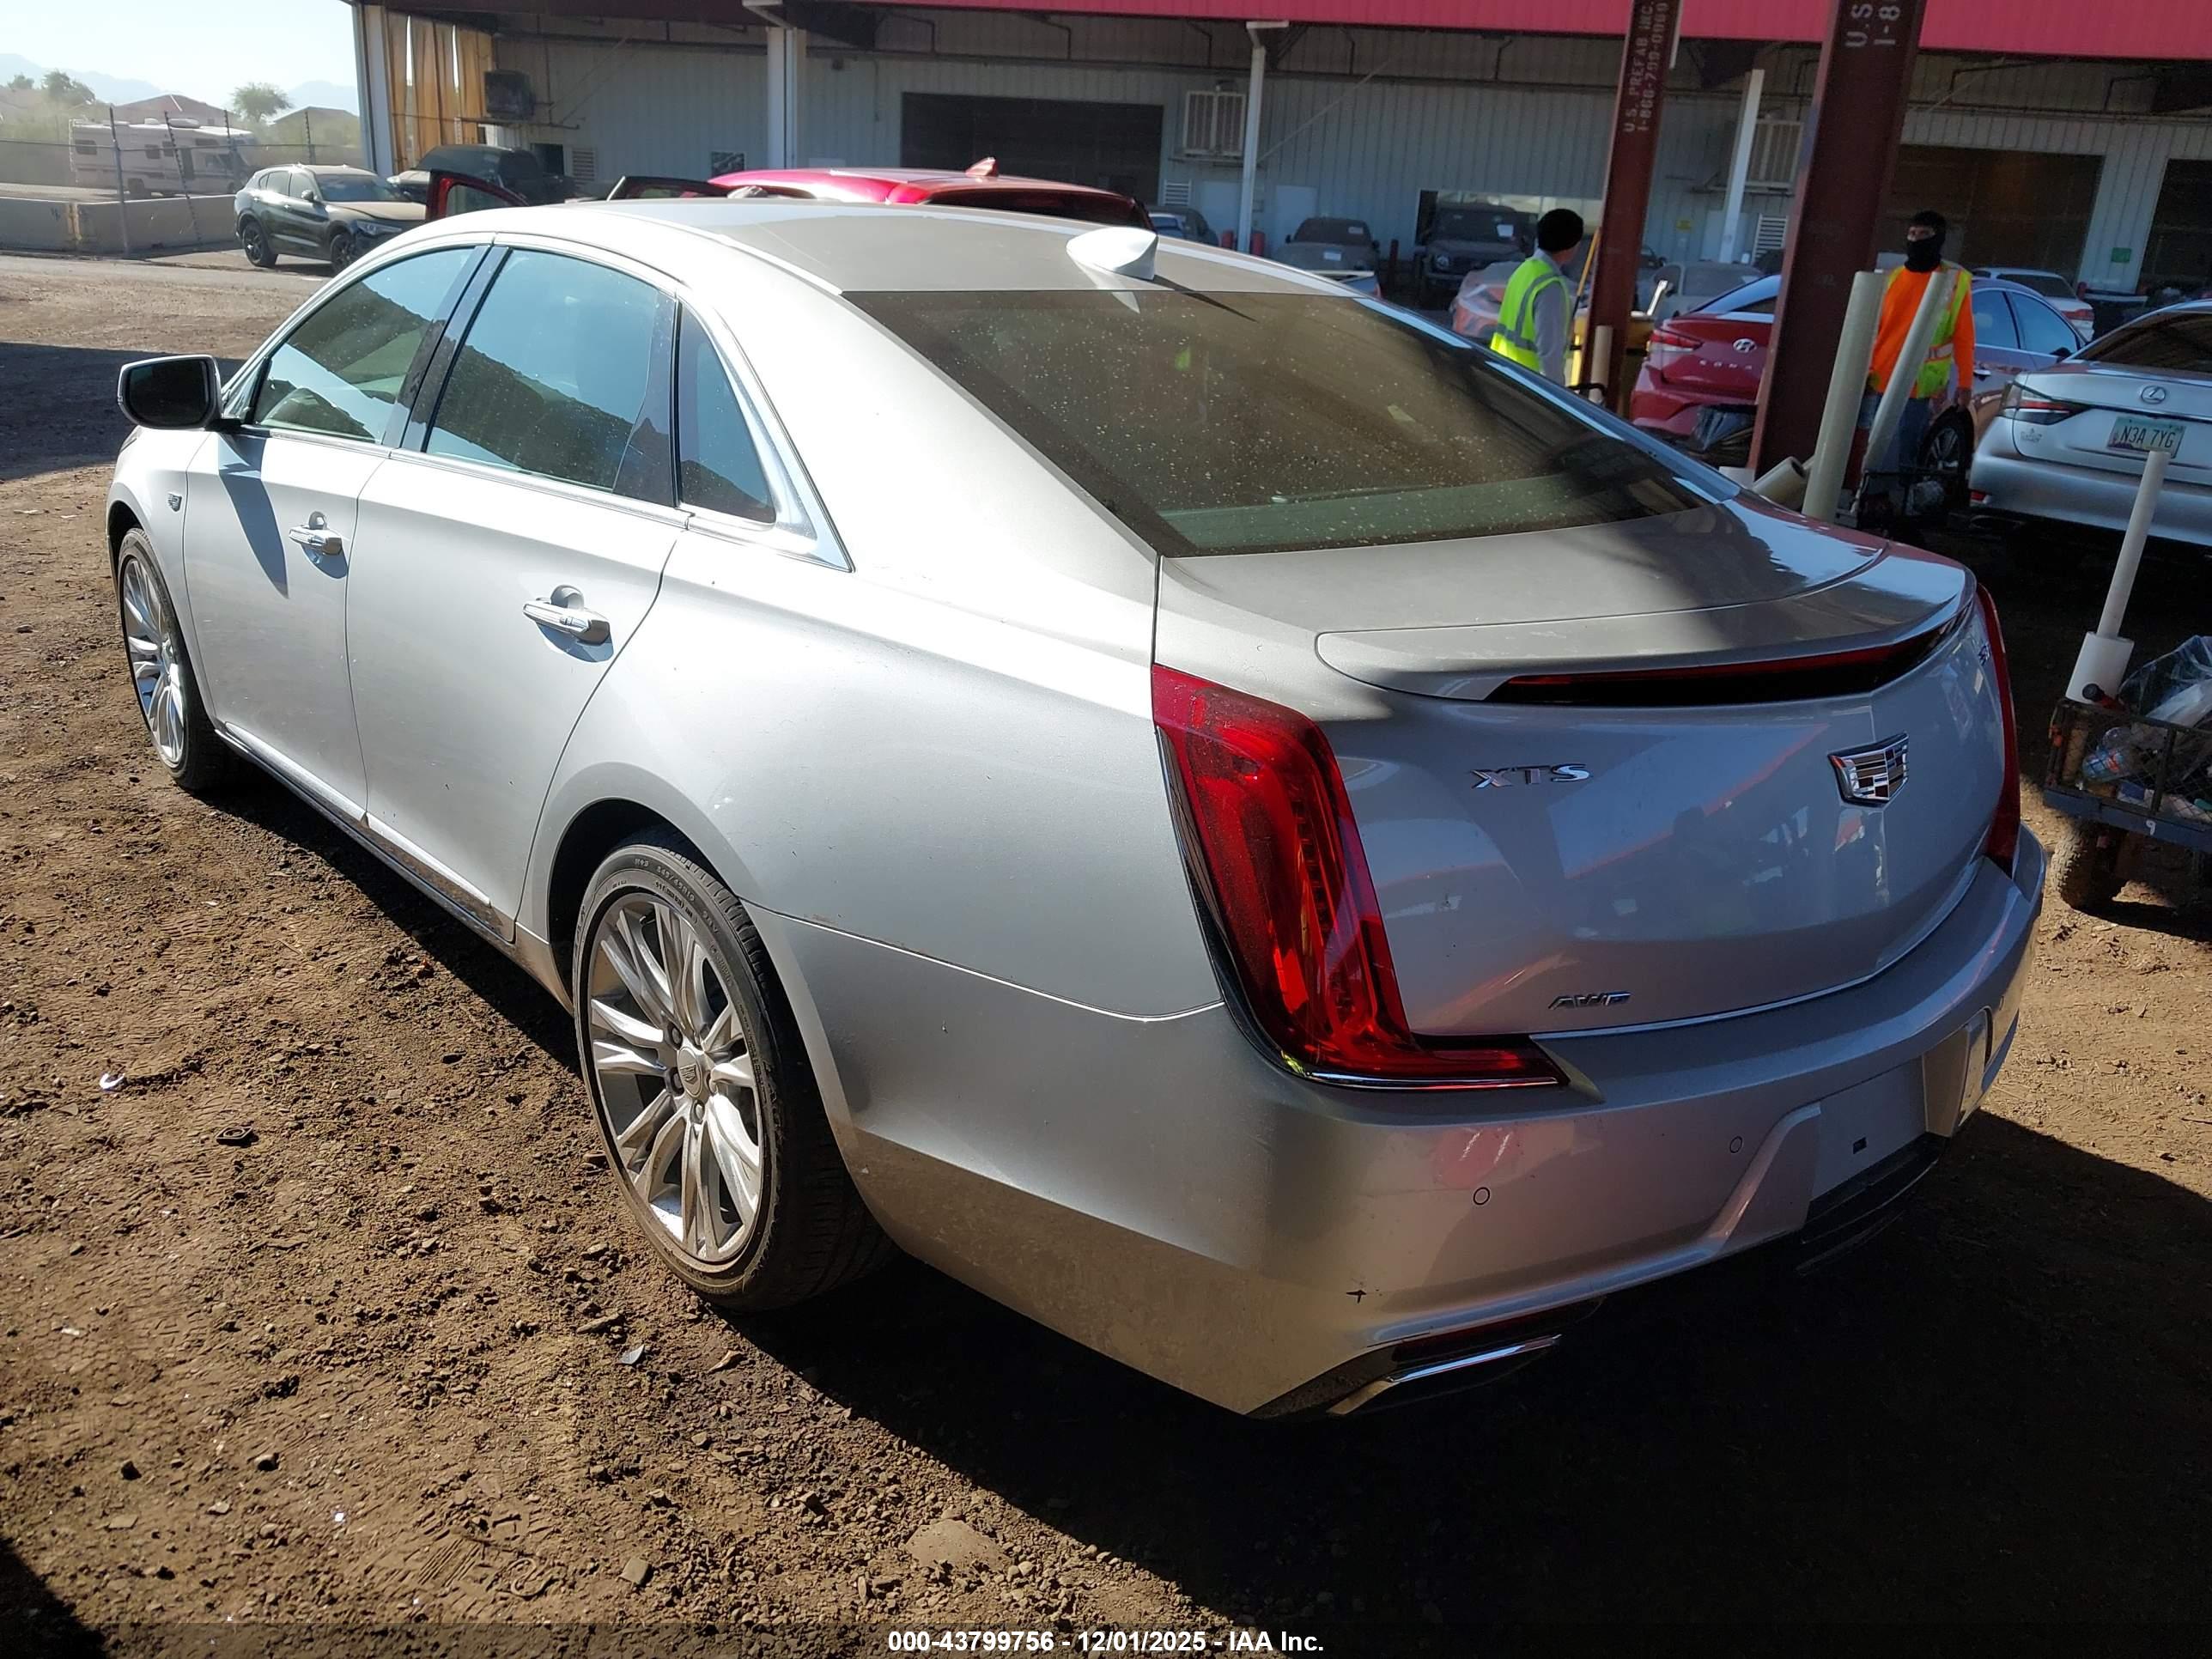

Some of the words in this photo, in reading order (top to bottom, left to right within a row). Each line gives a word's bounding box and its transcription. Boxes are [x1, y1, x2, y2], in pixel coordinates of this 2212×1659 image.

[1873, 0, 1902, 46] 1-8
[1628, 37, 1648, 96] PREFAB
[2120, 425, 2147, 445] N3A
[2149, 428, 2176, 448] 7YG
[1469, 763, 1591, 789] XTS
[2146, 819, 2156, 836] 9
